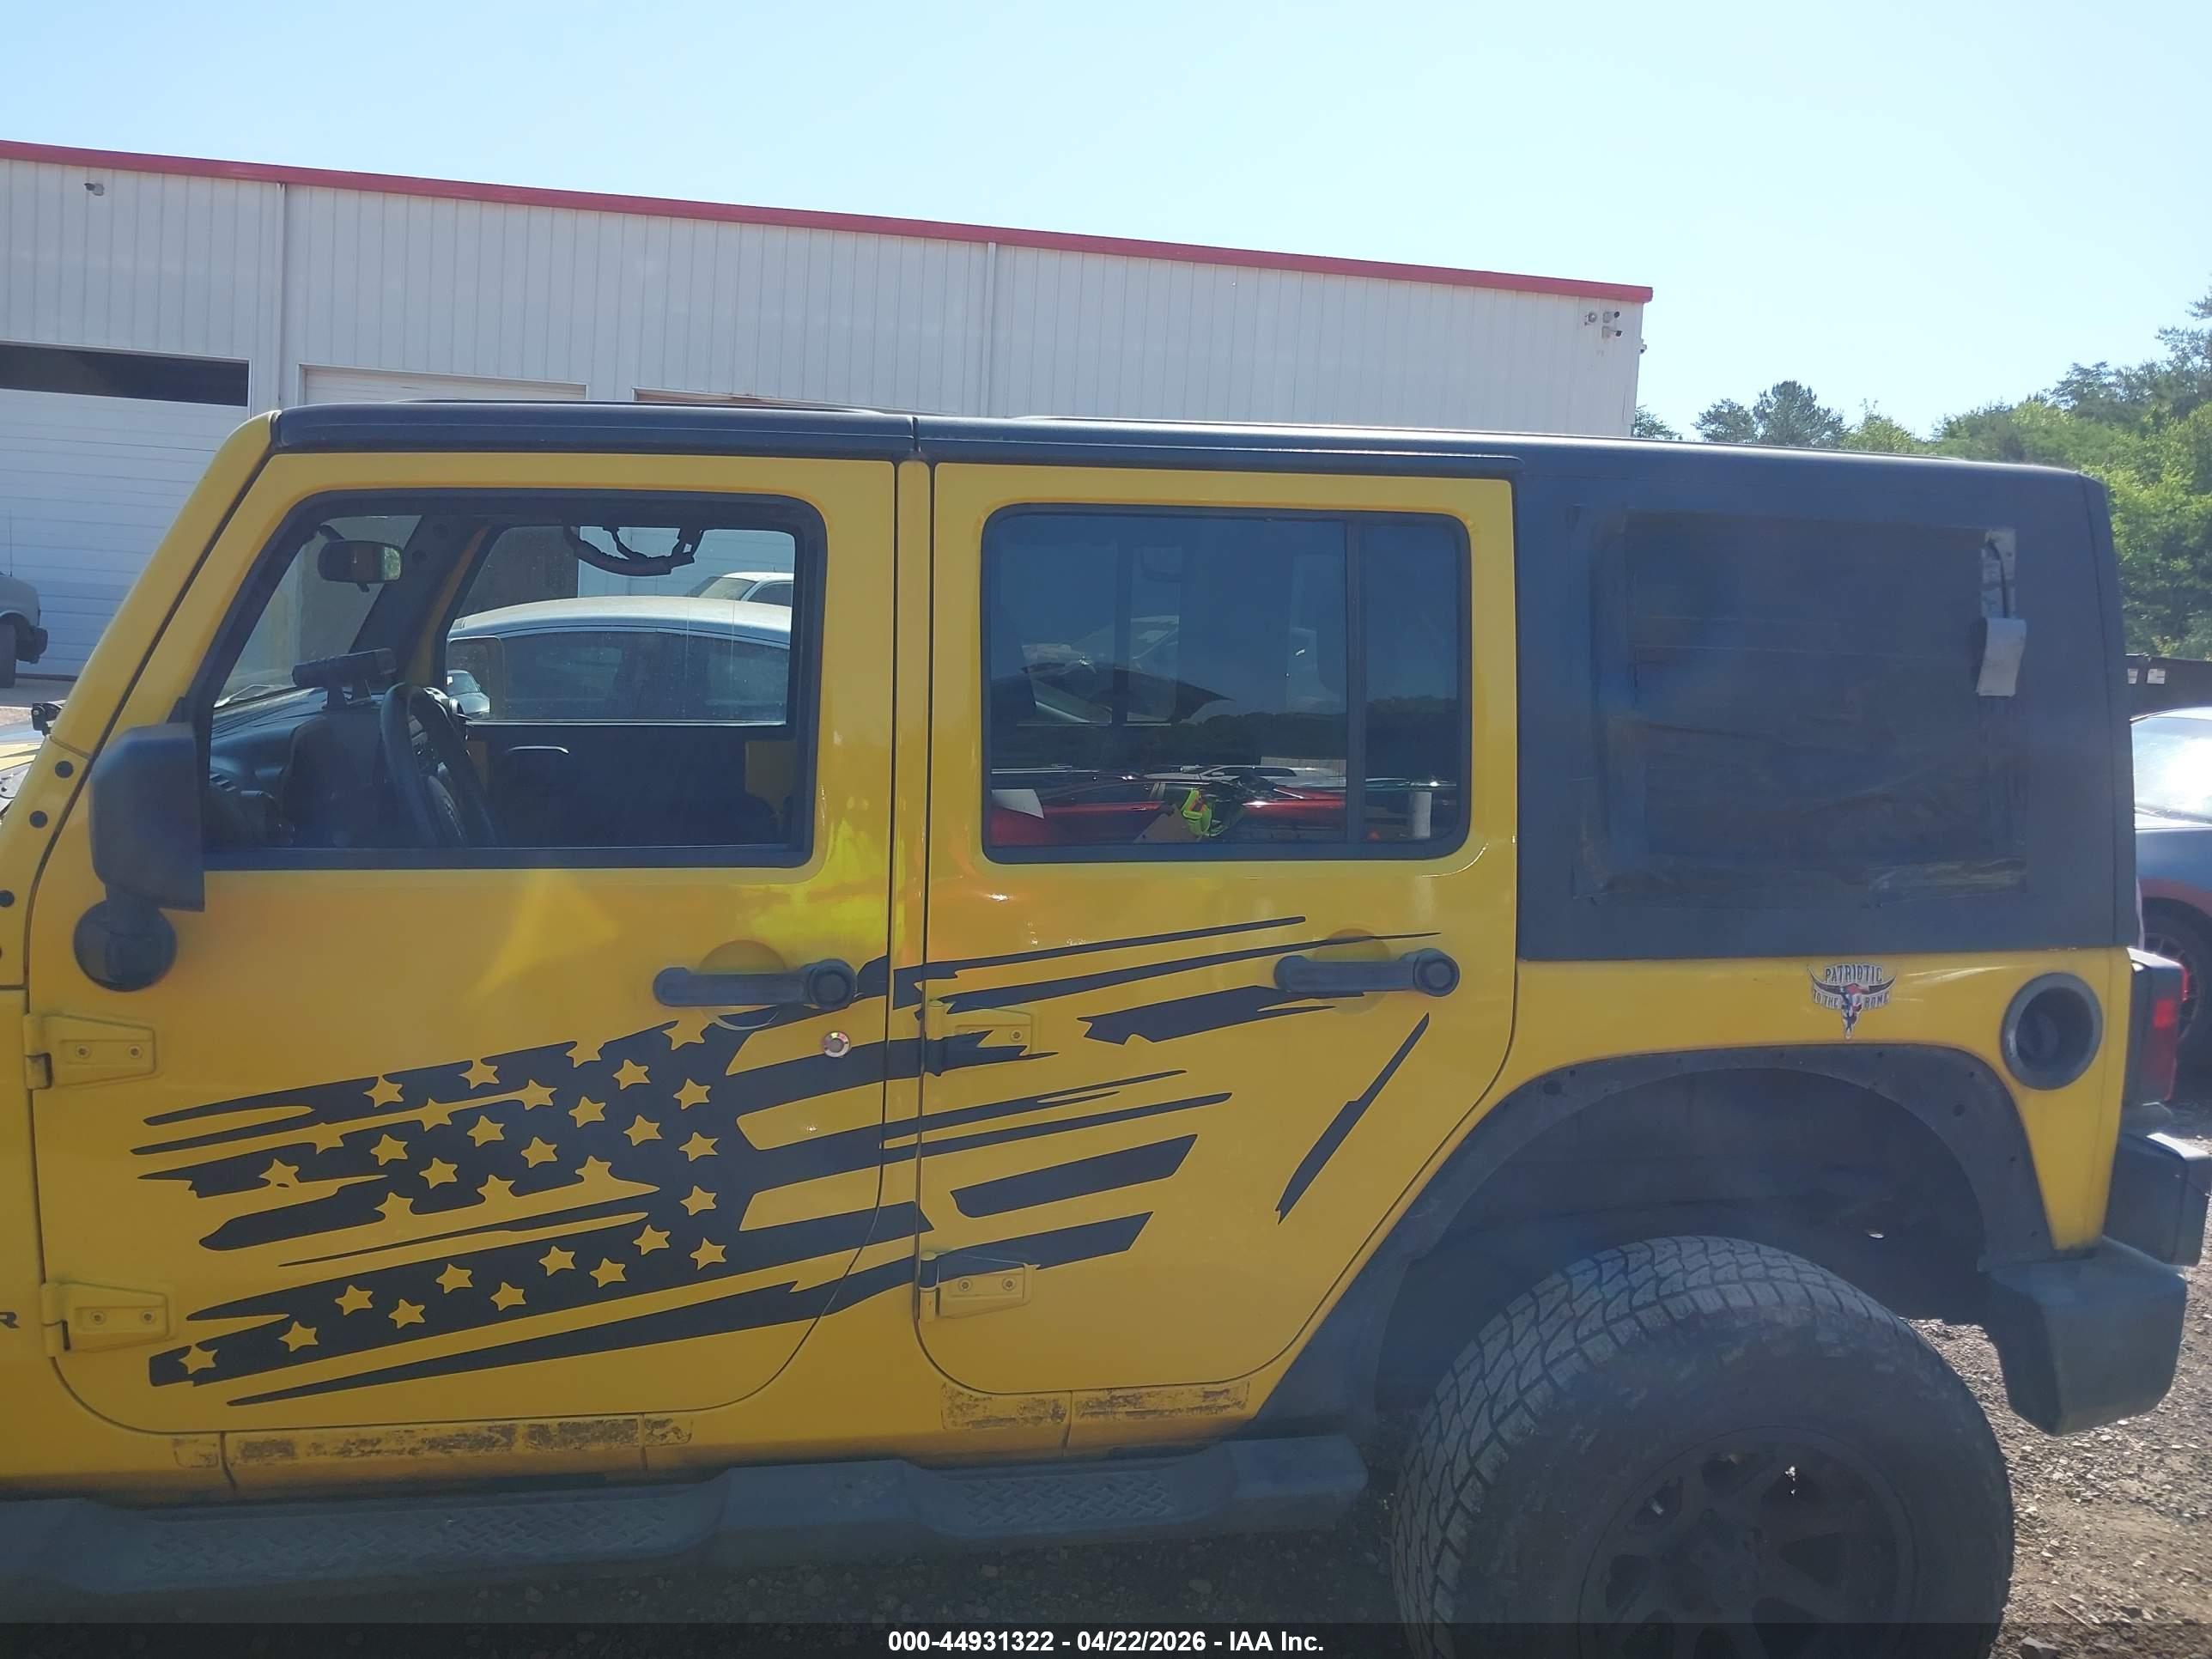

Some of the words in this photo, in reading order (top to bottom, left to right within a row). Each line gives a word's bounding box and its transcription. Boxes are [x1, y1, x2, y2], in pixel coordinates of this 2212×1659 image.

[1825, 963, 1883, 984] PATRIOTIC
[1813, 988, 1821, 1004] TO
[1824, 995, 1838, 1008] THE
[1864, 993, 1889, 1009] BONE
